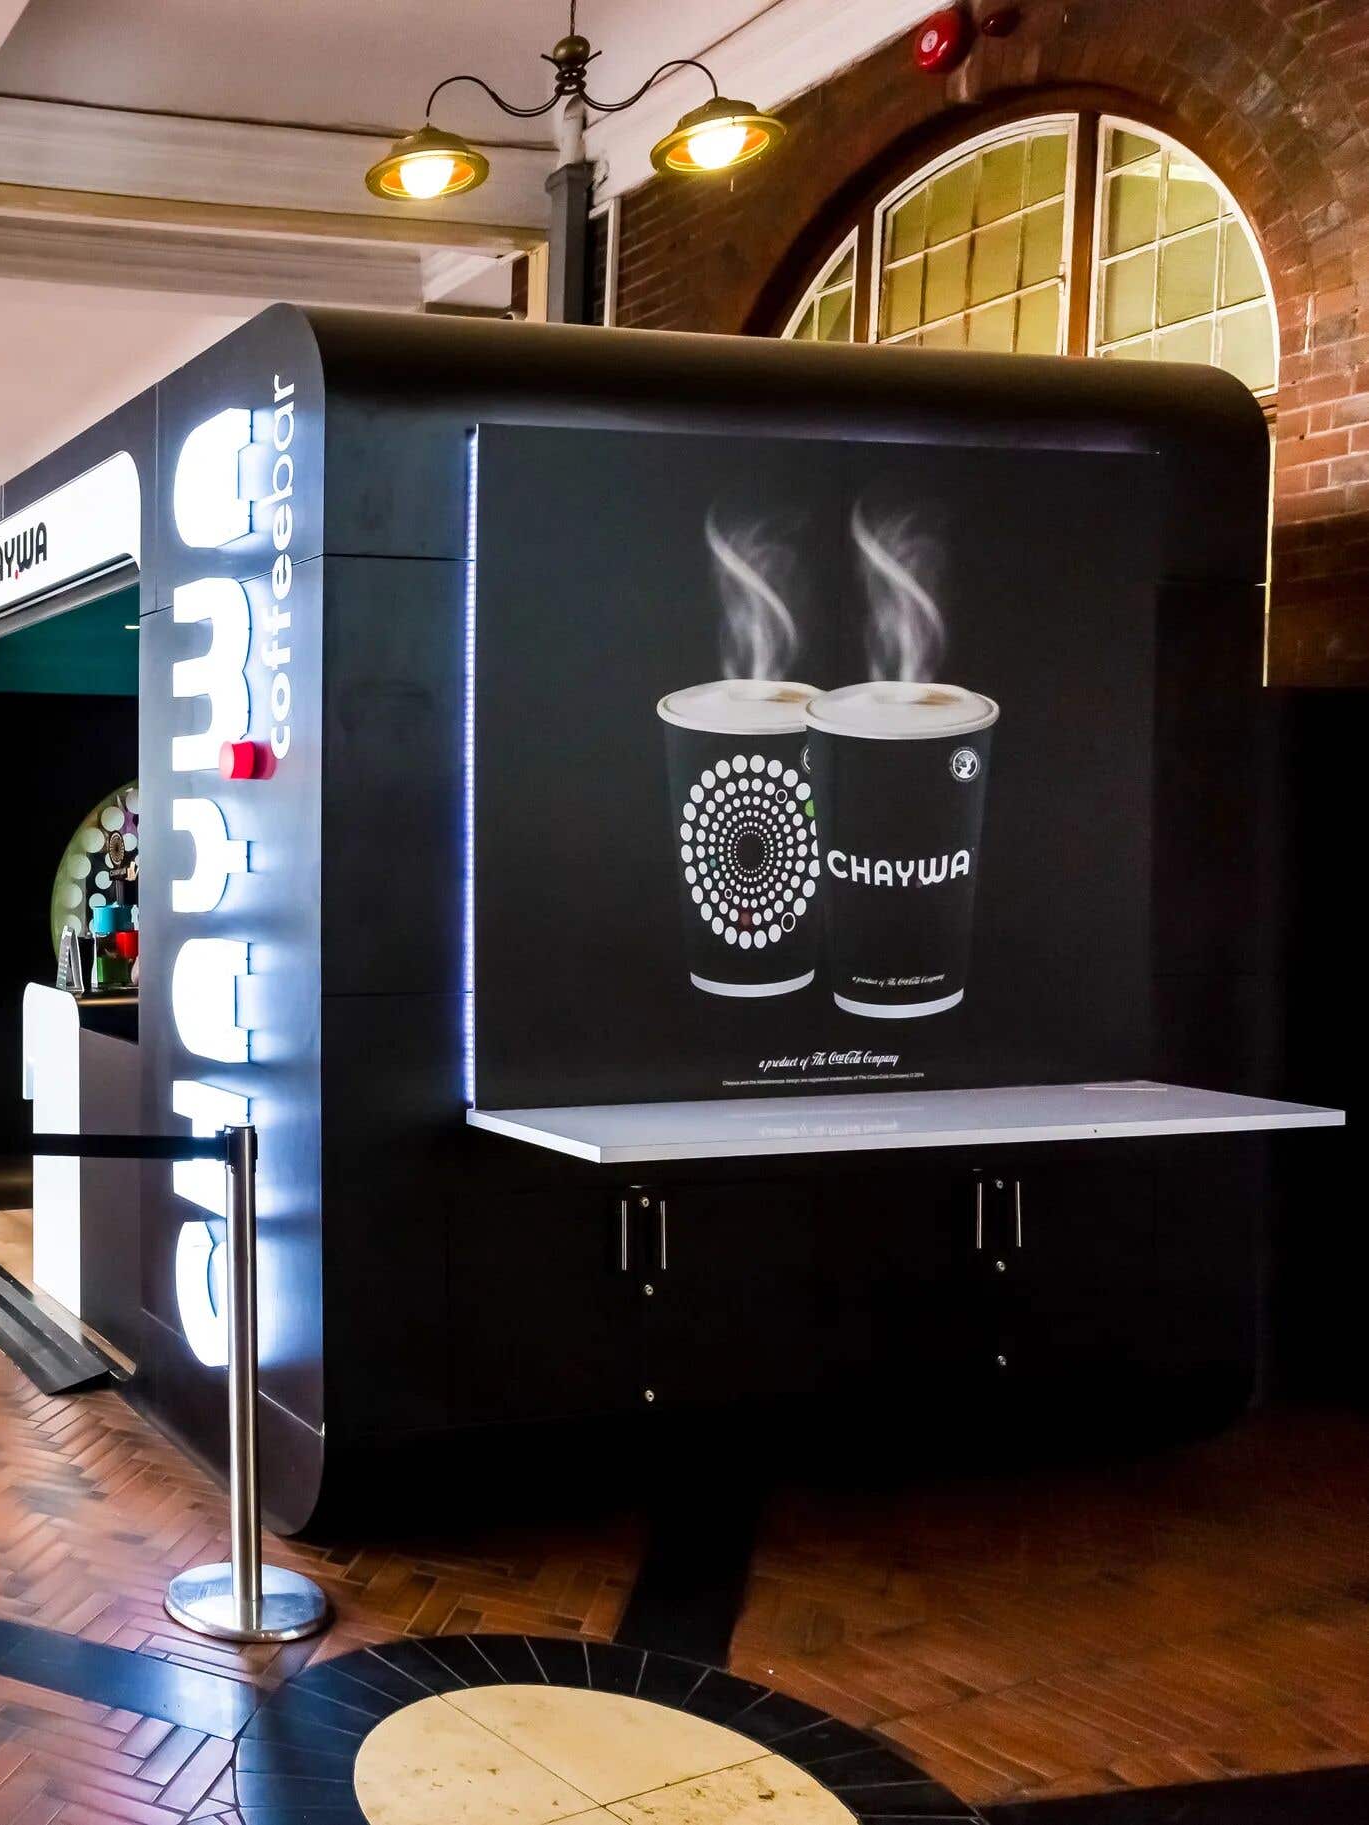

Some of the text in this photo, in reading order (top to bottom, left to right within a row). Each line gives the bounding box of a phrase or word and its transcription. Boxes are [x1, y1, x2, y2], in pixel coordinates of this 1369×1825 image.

[260, 374, 296, 760] coffeebar
[826, 849, 970, 887] CHAYWA
[758, 1060, 765, 1068] a
[764, 1057, 799, 1072] product
[799, 1056, 811, 1071] of
[811, 1051, 827, 1066] The
[863, 1050, 900, 1068] Company
